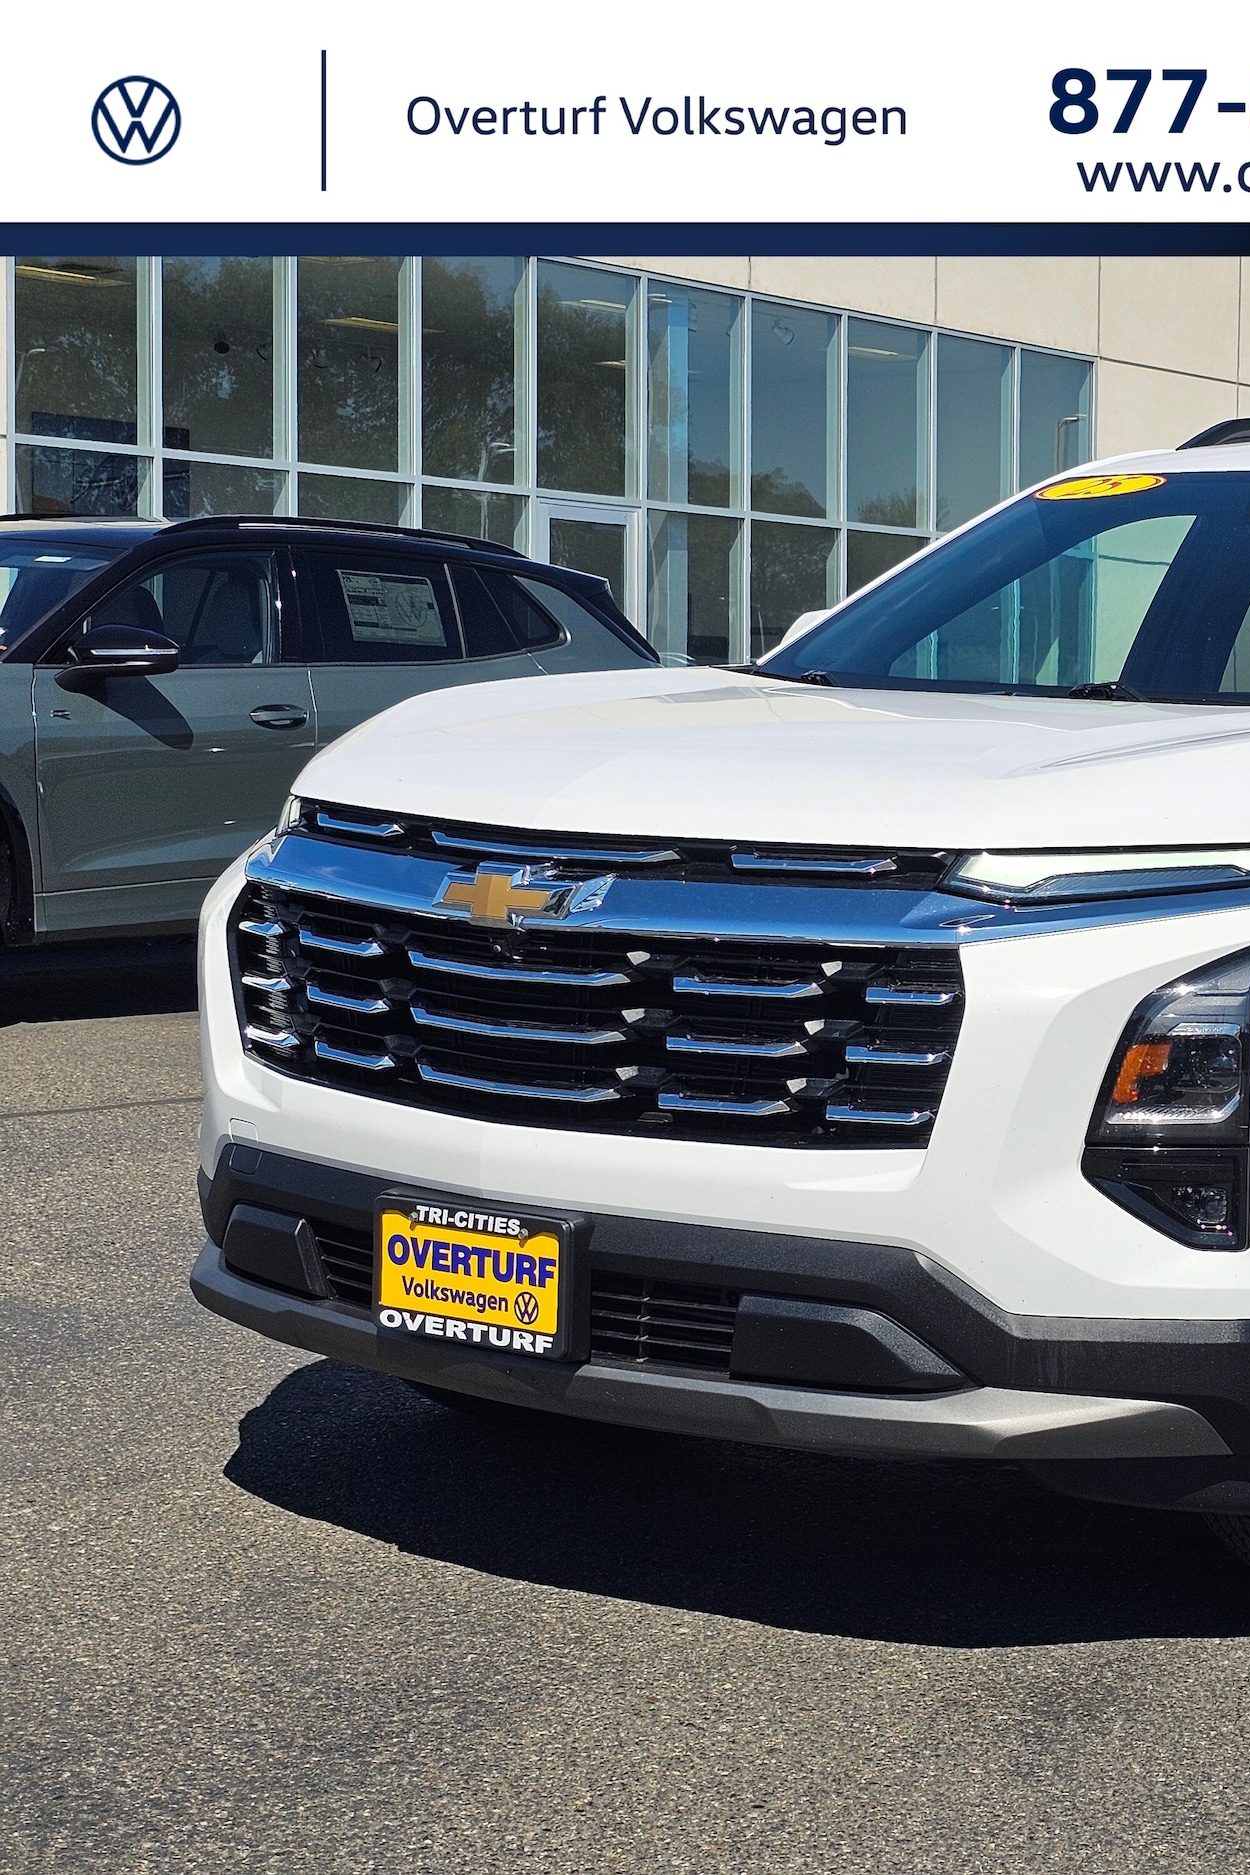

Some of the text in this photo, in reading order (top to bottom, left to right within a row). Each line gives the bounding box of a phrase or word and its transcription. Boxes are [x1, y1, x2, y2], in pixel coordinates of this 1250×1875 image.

[415, 1204, 523, 1237] TRI-CITIES
[387, 1233, 557, 1289] OVERTURF
[401, 1274, 510, 1314] Volkswagen
[379, 1309, 554, 1354] OVERTURF
